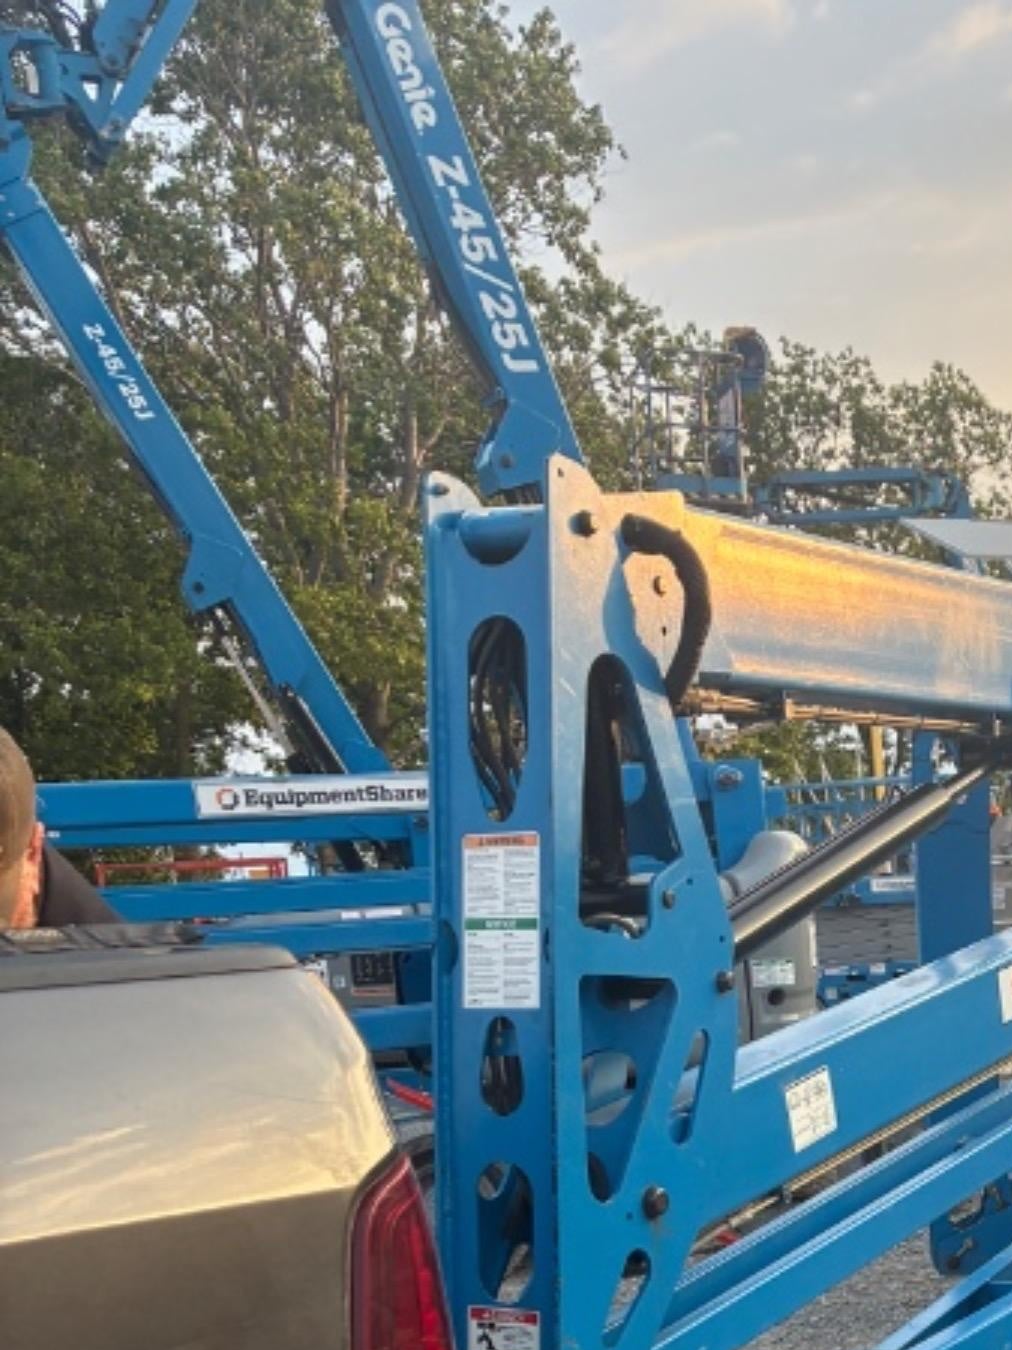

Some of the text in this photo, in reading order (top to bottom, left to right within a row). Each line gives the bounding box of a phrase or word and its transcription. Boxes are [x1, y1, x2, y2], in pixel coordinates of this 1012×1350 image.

[375, 3, 541, 374] Genie Z-45/25J
[82, 322, 156, 420] Z-45/25J
[242, 784, 428, 809] EquipmentShare
